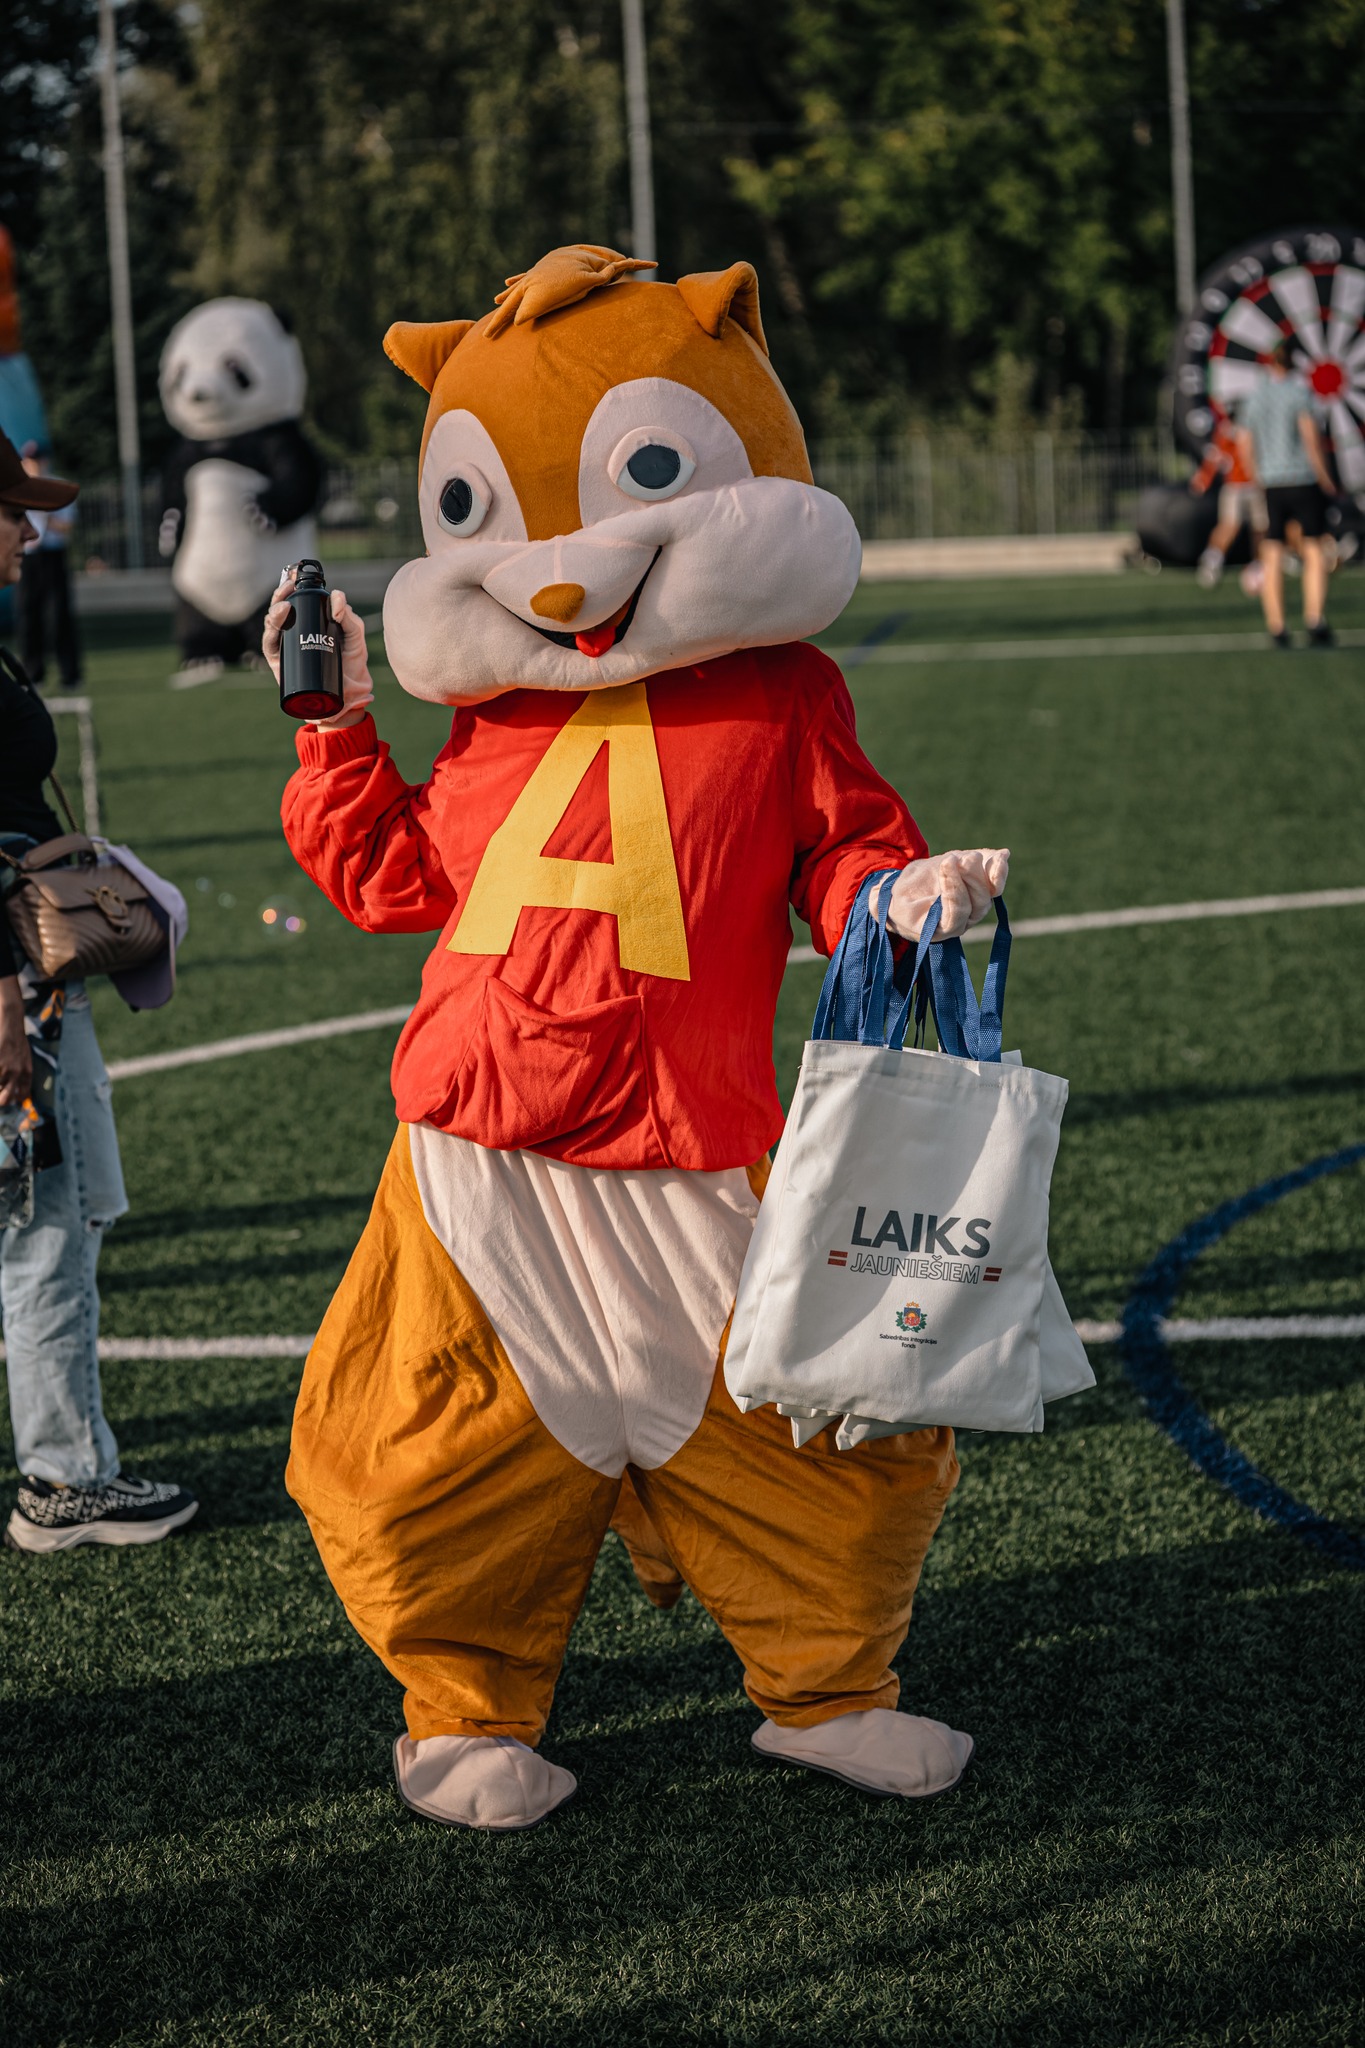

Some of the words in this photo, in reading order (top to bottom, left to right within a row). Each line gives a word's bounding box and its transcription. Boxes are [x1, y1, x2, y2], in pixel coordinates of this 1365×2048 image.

[299, 633, 335, 647] LAIKS
[446, 682, 690, 981] A
[851, 1206, 992, 1259] LAIKS
[850, 1253, 980, 1284] JAUNIEŠIEM
